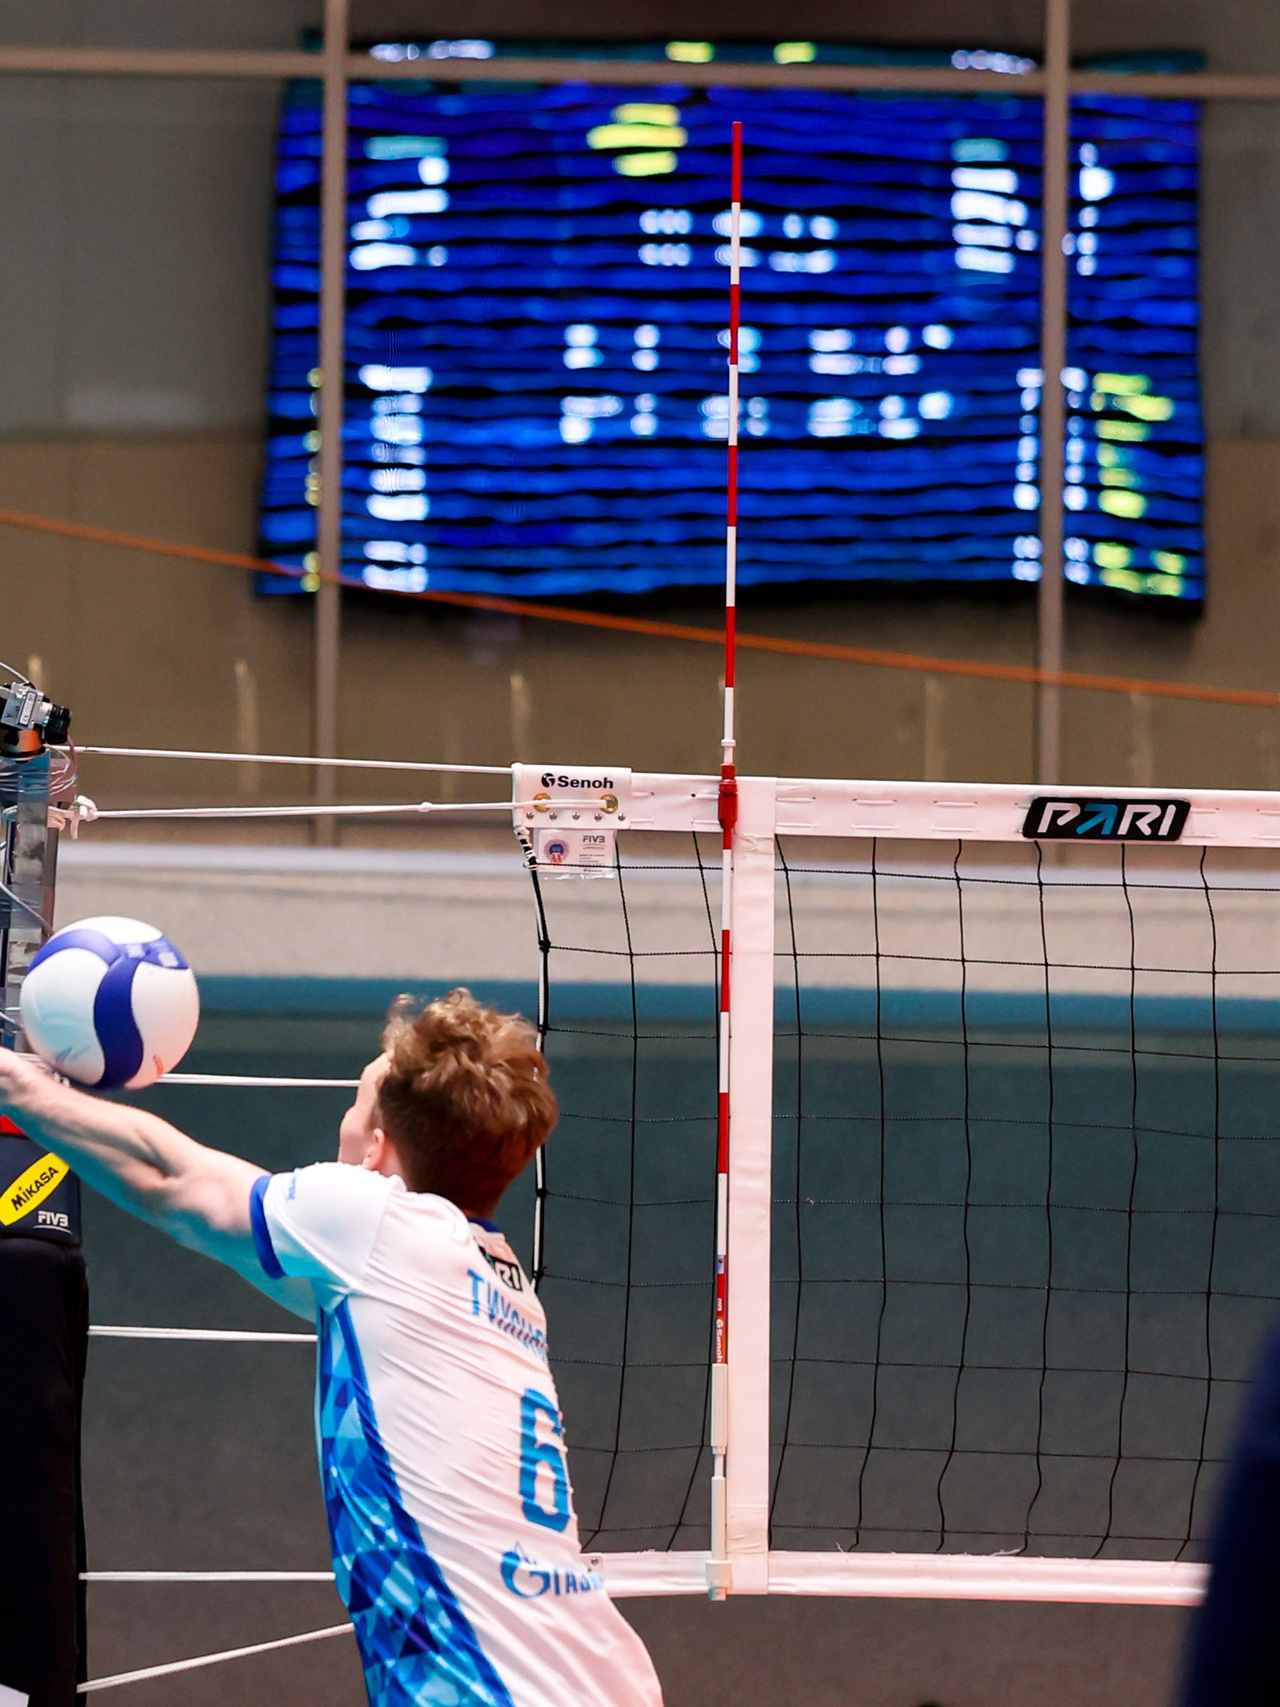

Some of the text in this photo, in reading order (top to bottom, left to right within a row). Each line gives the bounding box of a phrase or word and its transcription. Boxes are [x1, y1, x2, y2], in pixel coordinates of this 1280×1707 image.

[557, 775, 614, 789] Senoh
[1036, 801, 1177, 836] PARI
[10, 1166, 60, 1212] MIKASA
[518, 1387, 571, 1534] 6
